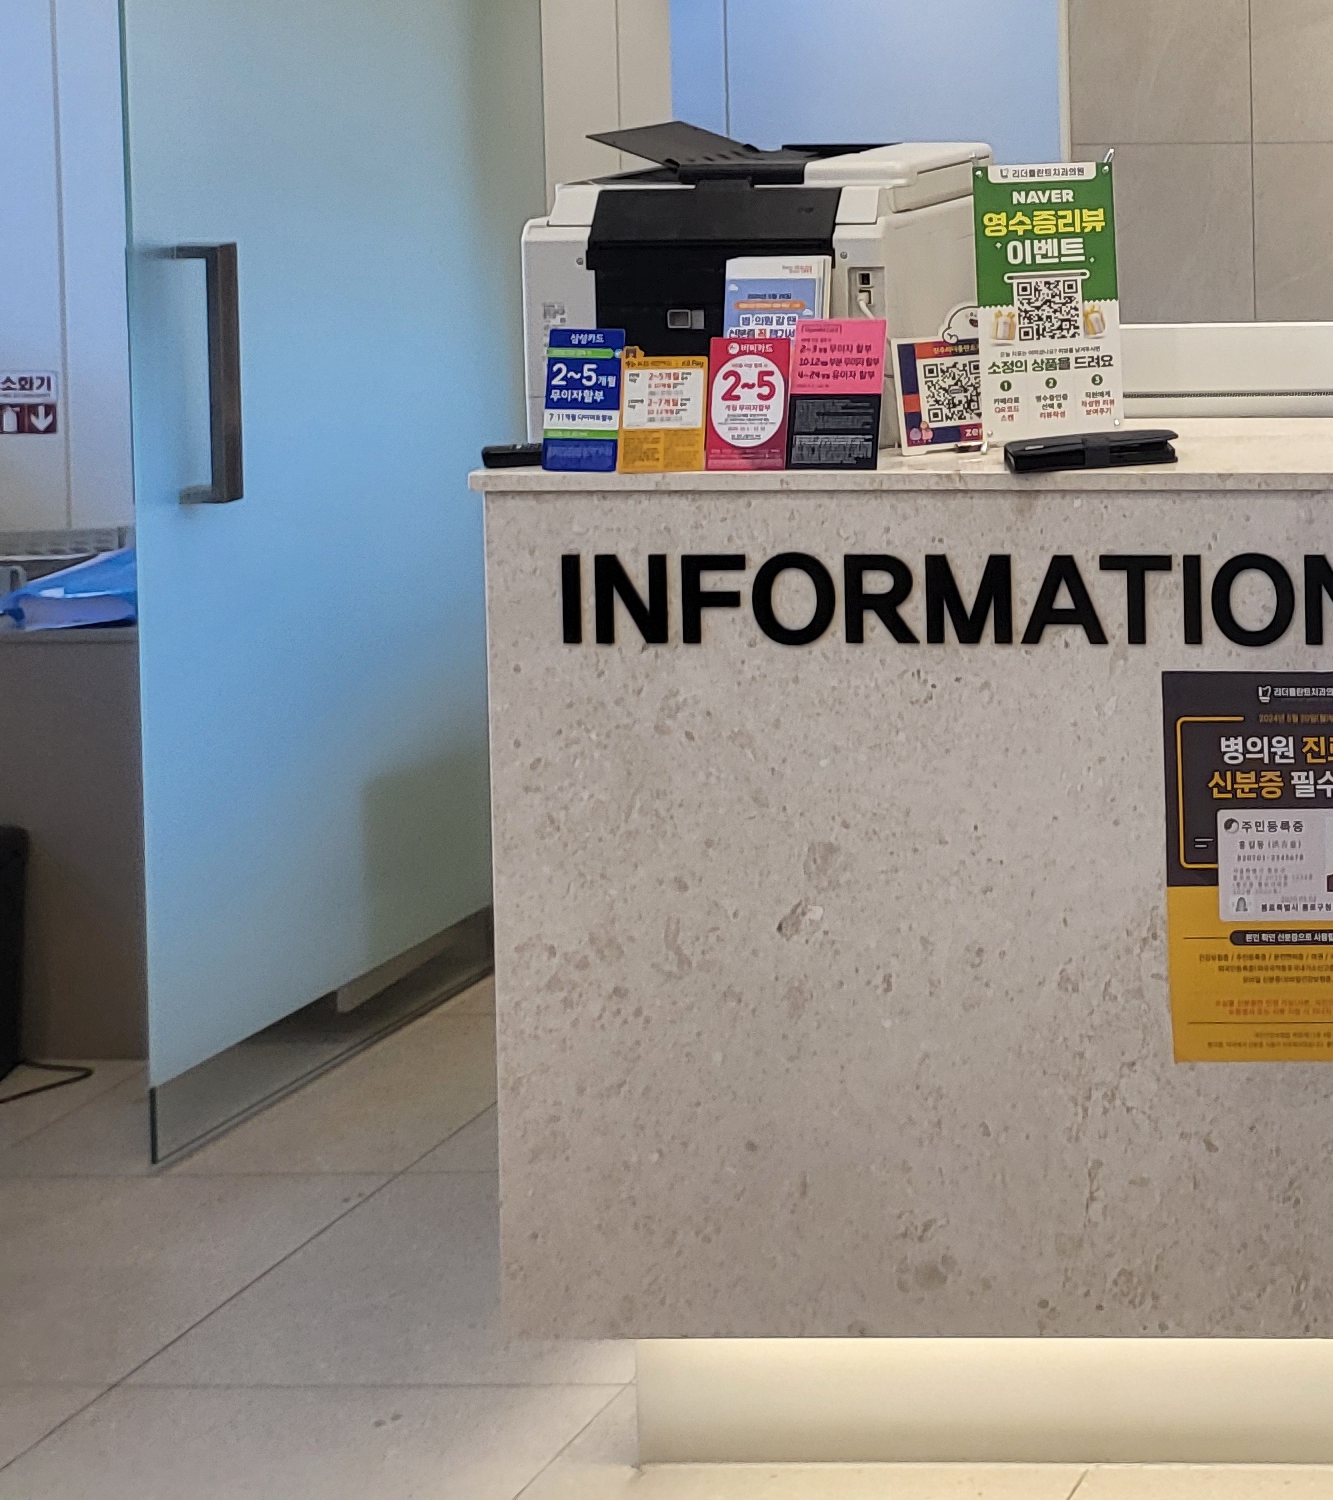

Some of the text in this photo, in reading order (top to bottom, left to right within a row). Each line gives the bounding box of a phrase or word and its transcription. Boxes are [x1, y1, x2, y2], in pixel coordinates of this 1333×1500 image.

[1011, 189, 1075, 205] NAVER
[982, 207, 1106, 237] 영수증리뷰
[1006, 237, 1086, 265] 이벤트
[570, 332, 605, 345] 삼성카드
[987, 354, 1114, 375] 소정의 상품을 드려요
[0, 375, 52, 392] 소화기
[549, 388, 605, 403] 무이자할부
[720, 369, 777, 402] 2~5
[1220, 735, 1296, 765] 병의원
[1207, 770, 1285, 800] 신분증
